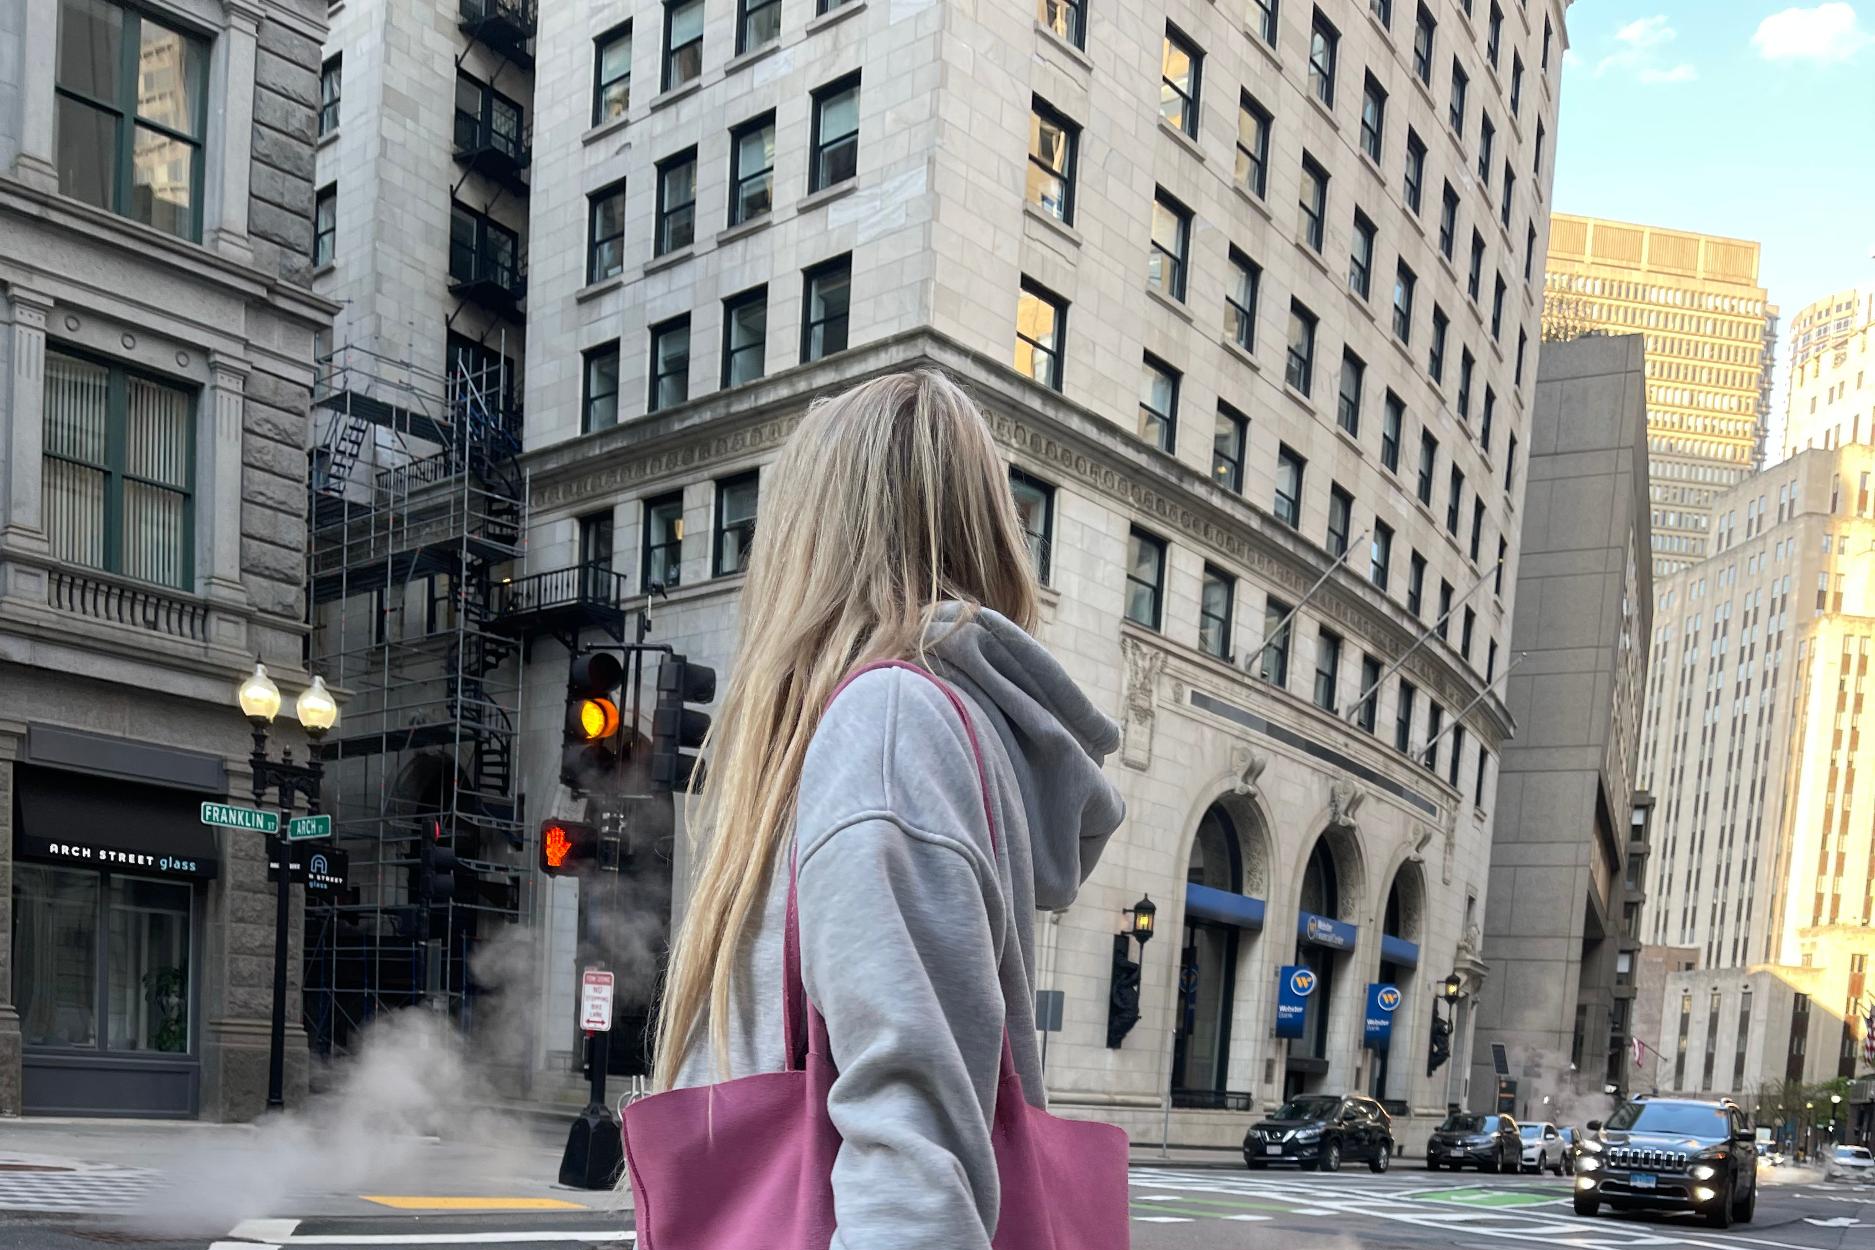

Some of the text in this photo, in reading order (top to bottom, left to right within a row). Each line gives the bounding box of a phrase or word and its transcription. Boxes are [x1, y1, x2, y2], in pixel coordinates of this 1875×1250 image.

[205, 805, 264, 829] FRANKLIN
[296, 818, 316, 836] ARCH
[49, 843, 197, 871] ARCH STREET glass
